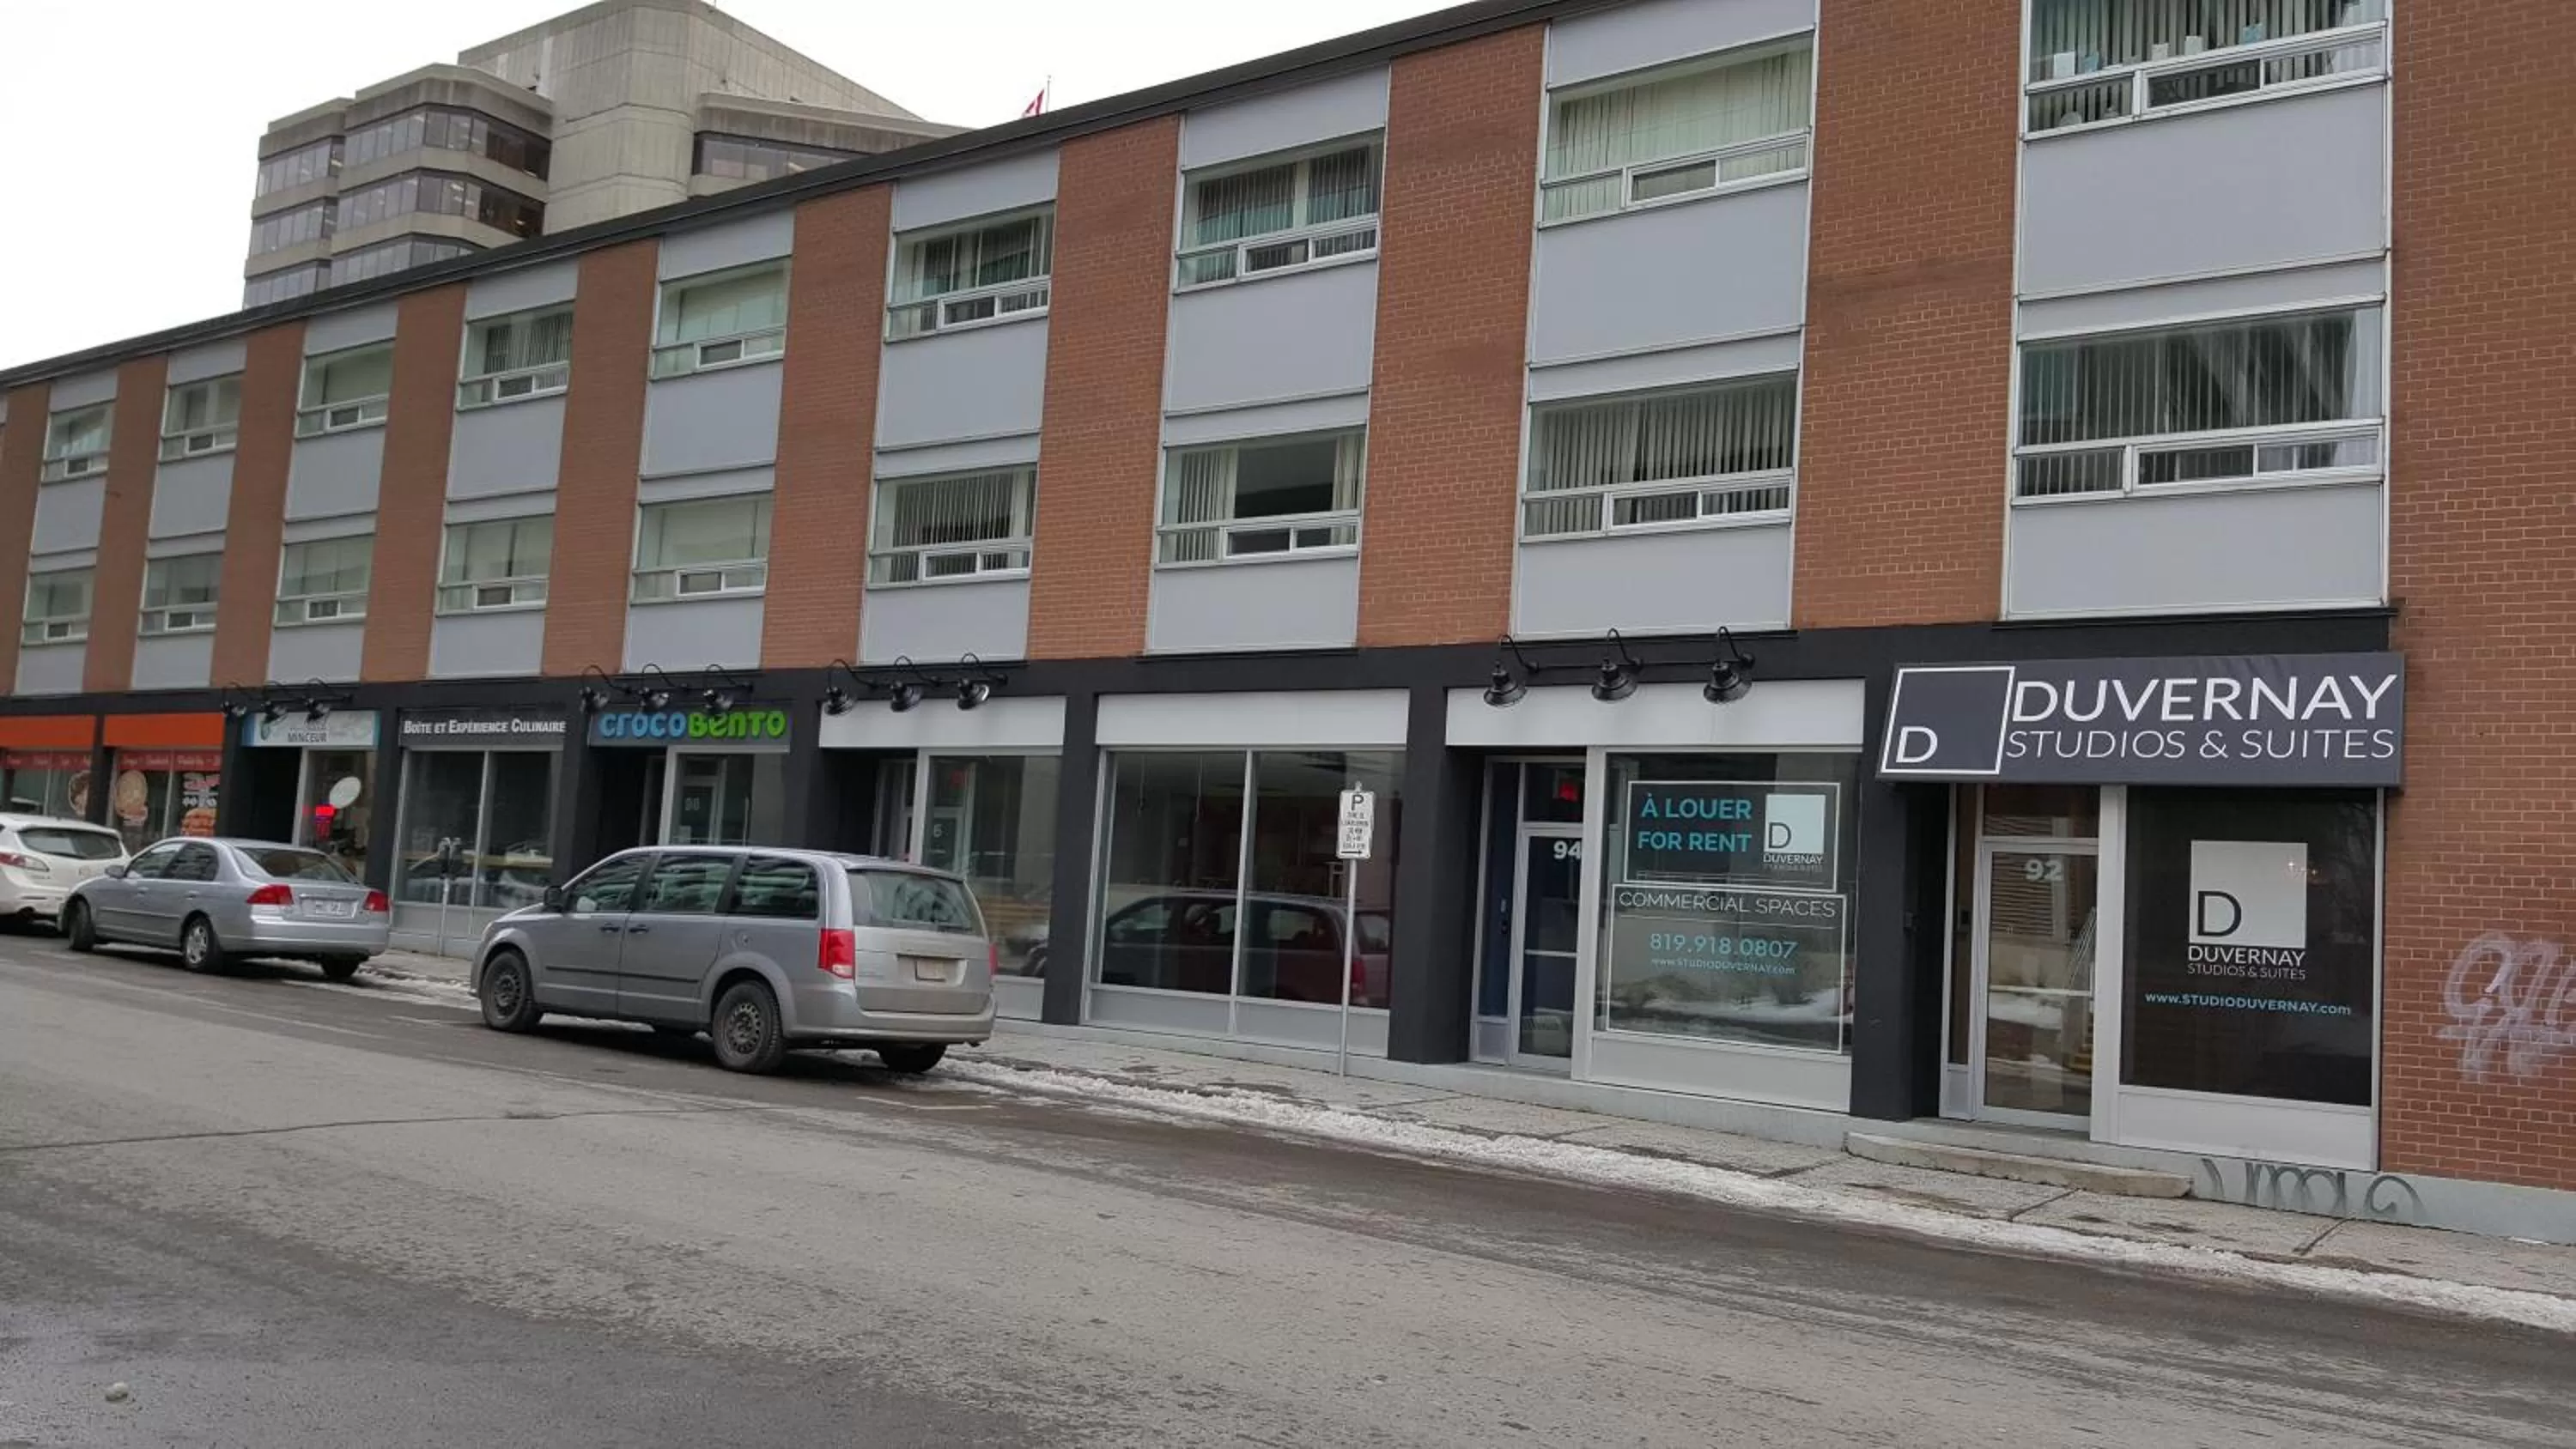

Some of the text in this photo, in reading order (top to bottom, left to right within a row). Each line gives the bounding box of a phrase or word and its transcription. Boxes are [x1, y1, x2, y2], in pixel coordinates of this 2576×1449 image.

[2012, 674, 2397, 723] DUVERNAY
[434, 722, 447, 734] ET
[511, 718, 567, 733] CULINAIRE
[1895, 726, 1938, 763] D
[2006, 729, 2396, 760] STUDIOS & SUITES
[1351, 794, 1364, 811] P
[1641, 794, 1753, 820] À LOUER
[1637, 831, 1753, 852] FOR RENT
[1768, 822, 1792, 849] D
[1553, 840, 1581, 859] 94
[1763, 852, 1824, 865] DUVERNAY
[2025, 859, 2063, 881] 92
[1619, 892, 1837, 919] COMMERCIAL SPACES
[2197, 890, 2242, 937] D
[1649, 933, 1799, 959] 819.918.0807
[2188, 945, 2306, 967] DUVERNAY
[2187, 962, 2306, 980] STUDIOS & SUITES
[2145, 992, 2351, 1016] www.STUDIODUVERNAY.com
